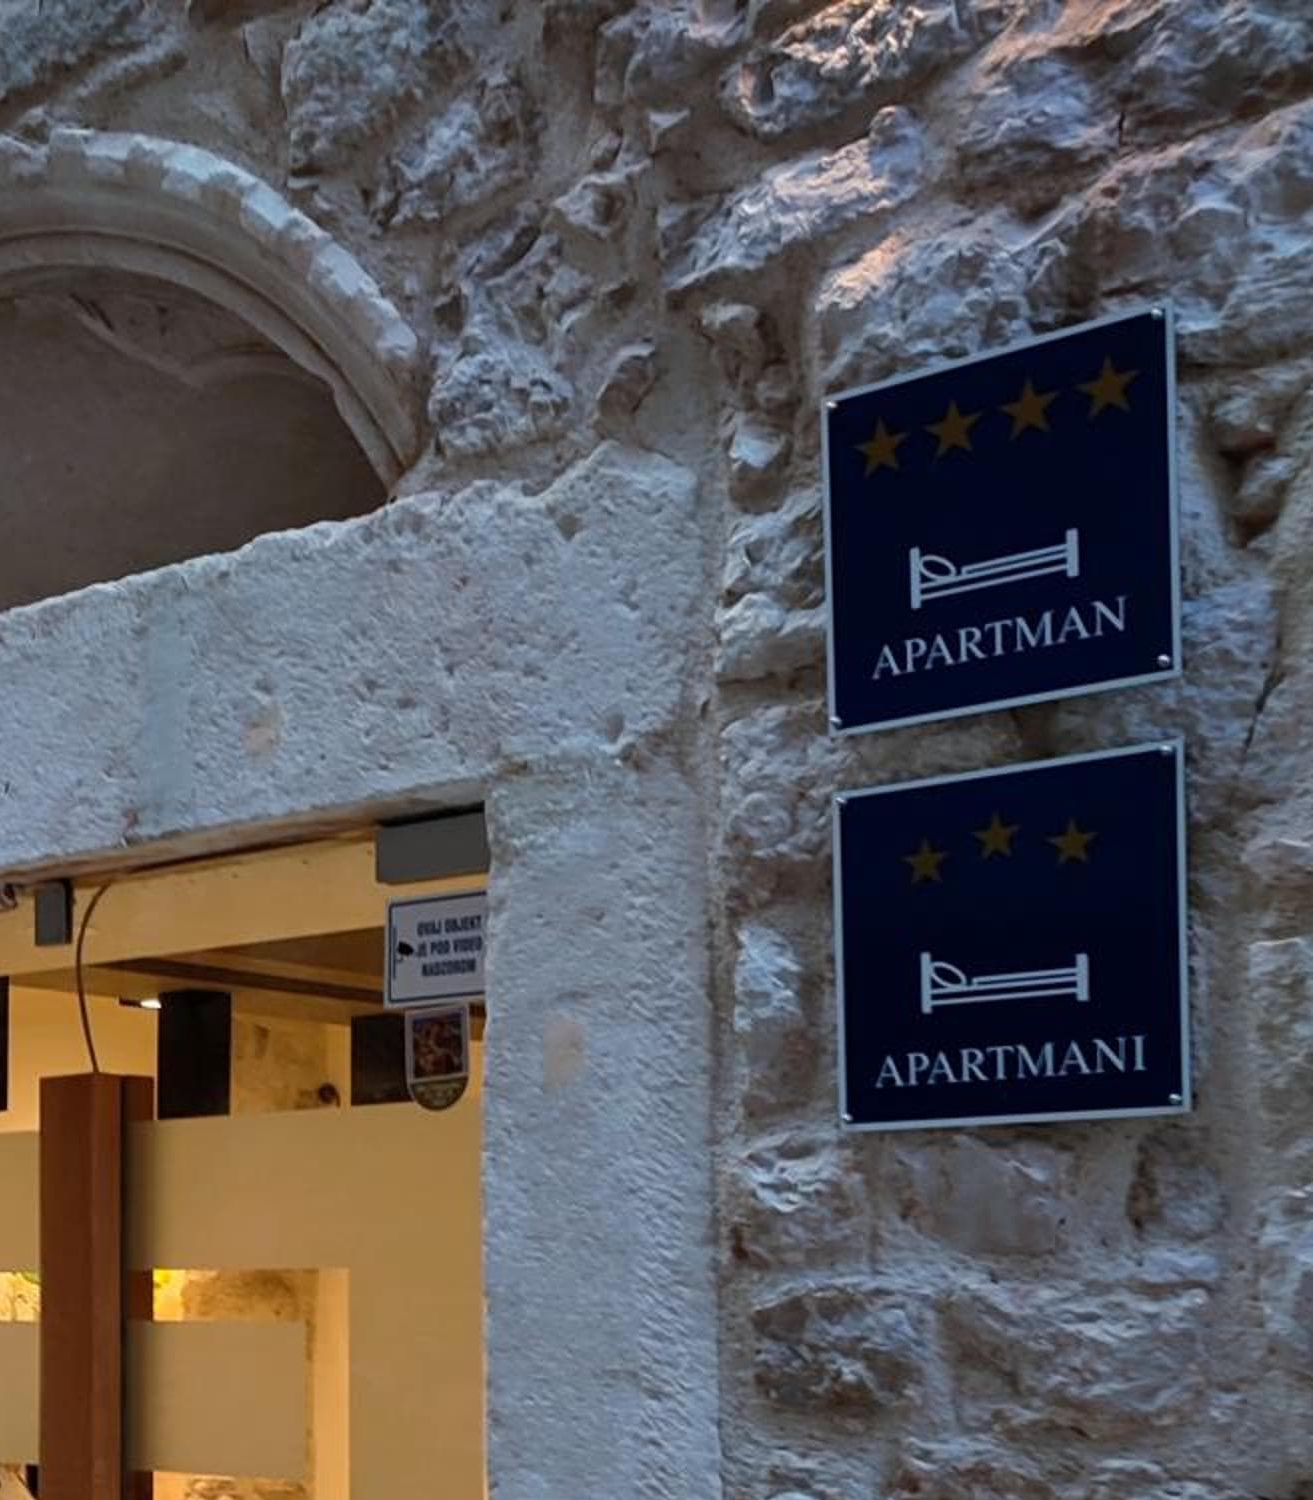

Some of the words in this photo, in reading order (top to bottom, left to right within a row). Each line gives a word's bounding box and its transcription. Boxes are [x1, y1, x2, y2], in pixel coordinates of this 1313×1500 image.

[872, 595, 1128, 680] APARTMAN
[417, 920, 441, 937] OVAJ
[445, 915, 482, 934] OBJEKT
[430, 939, 450, 956] POD
[453, 935, 483, 953] VIDEO
[422, 958, 476, 976] NADZOROM
[876, 1034, 1147, 1088] APARTMANI
